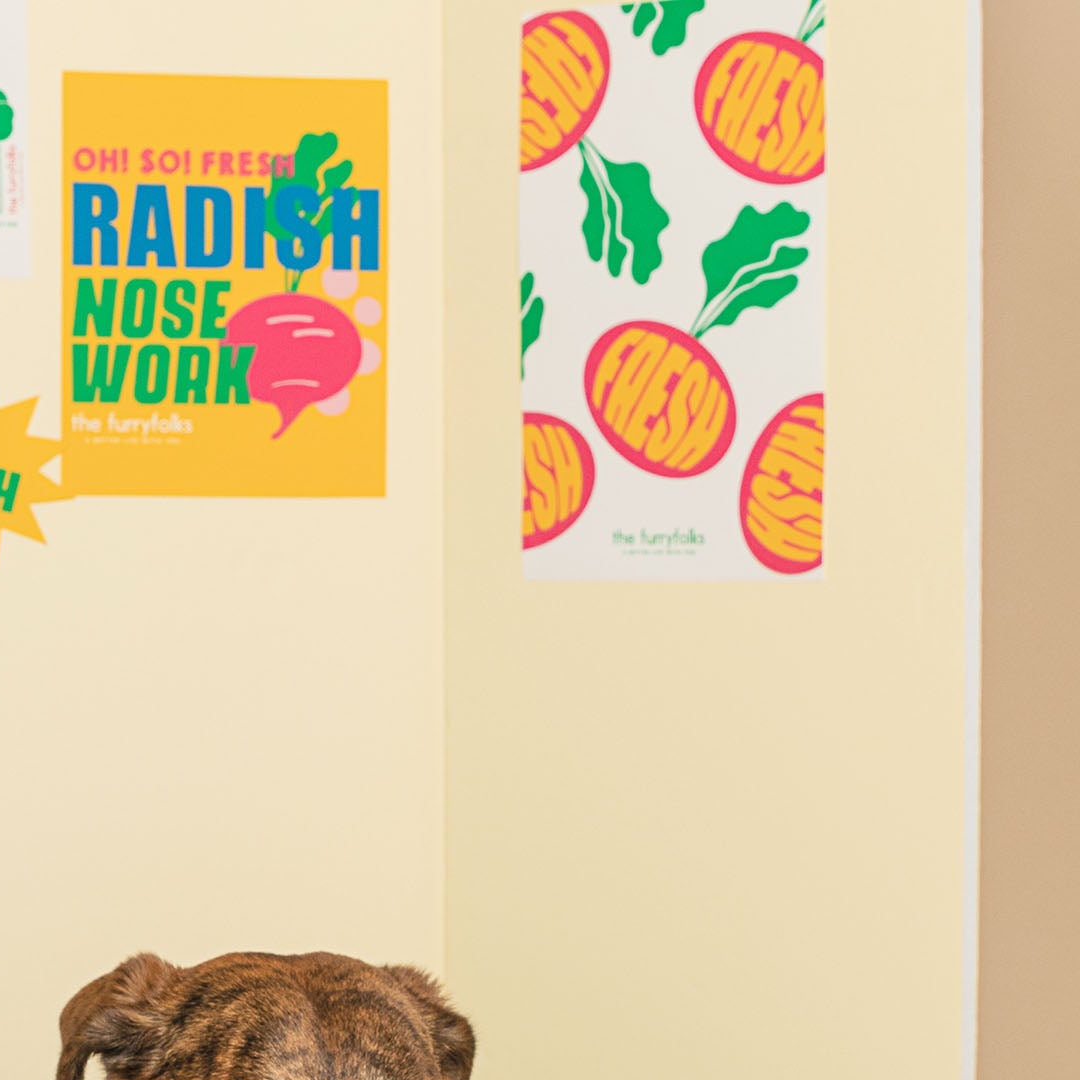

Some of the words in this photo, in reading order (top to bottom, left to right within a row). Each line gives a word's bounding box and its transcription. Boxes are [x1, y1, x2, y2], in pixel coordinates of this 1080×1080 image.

[520, 16, 605, 166] FRES
[73, 147, 128, 173] OH!
[140, 148, 191, 175] SO!
[201, 150, 295, 178] FRESH
[73, 183, 379, 271] RADISH
[73, 278, 231, 339] NOSE
[73, 344, 256, 404] WORK
[592, 328, 729, 471] FRESH
[71, 412, 101, 432] the
[107, 411, 193, 439] furryfolks
[612, 527, 634, 544] the
